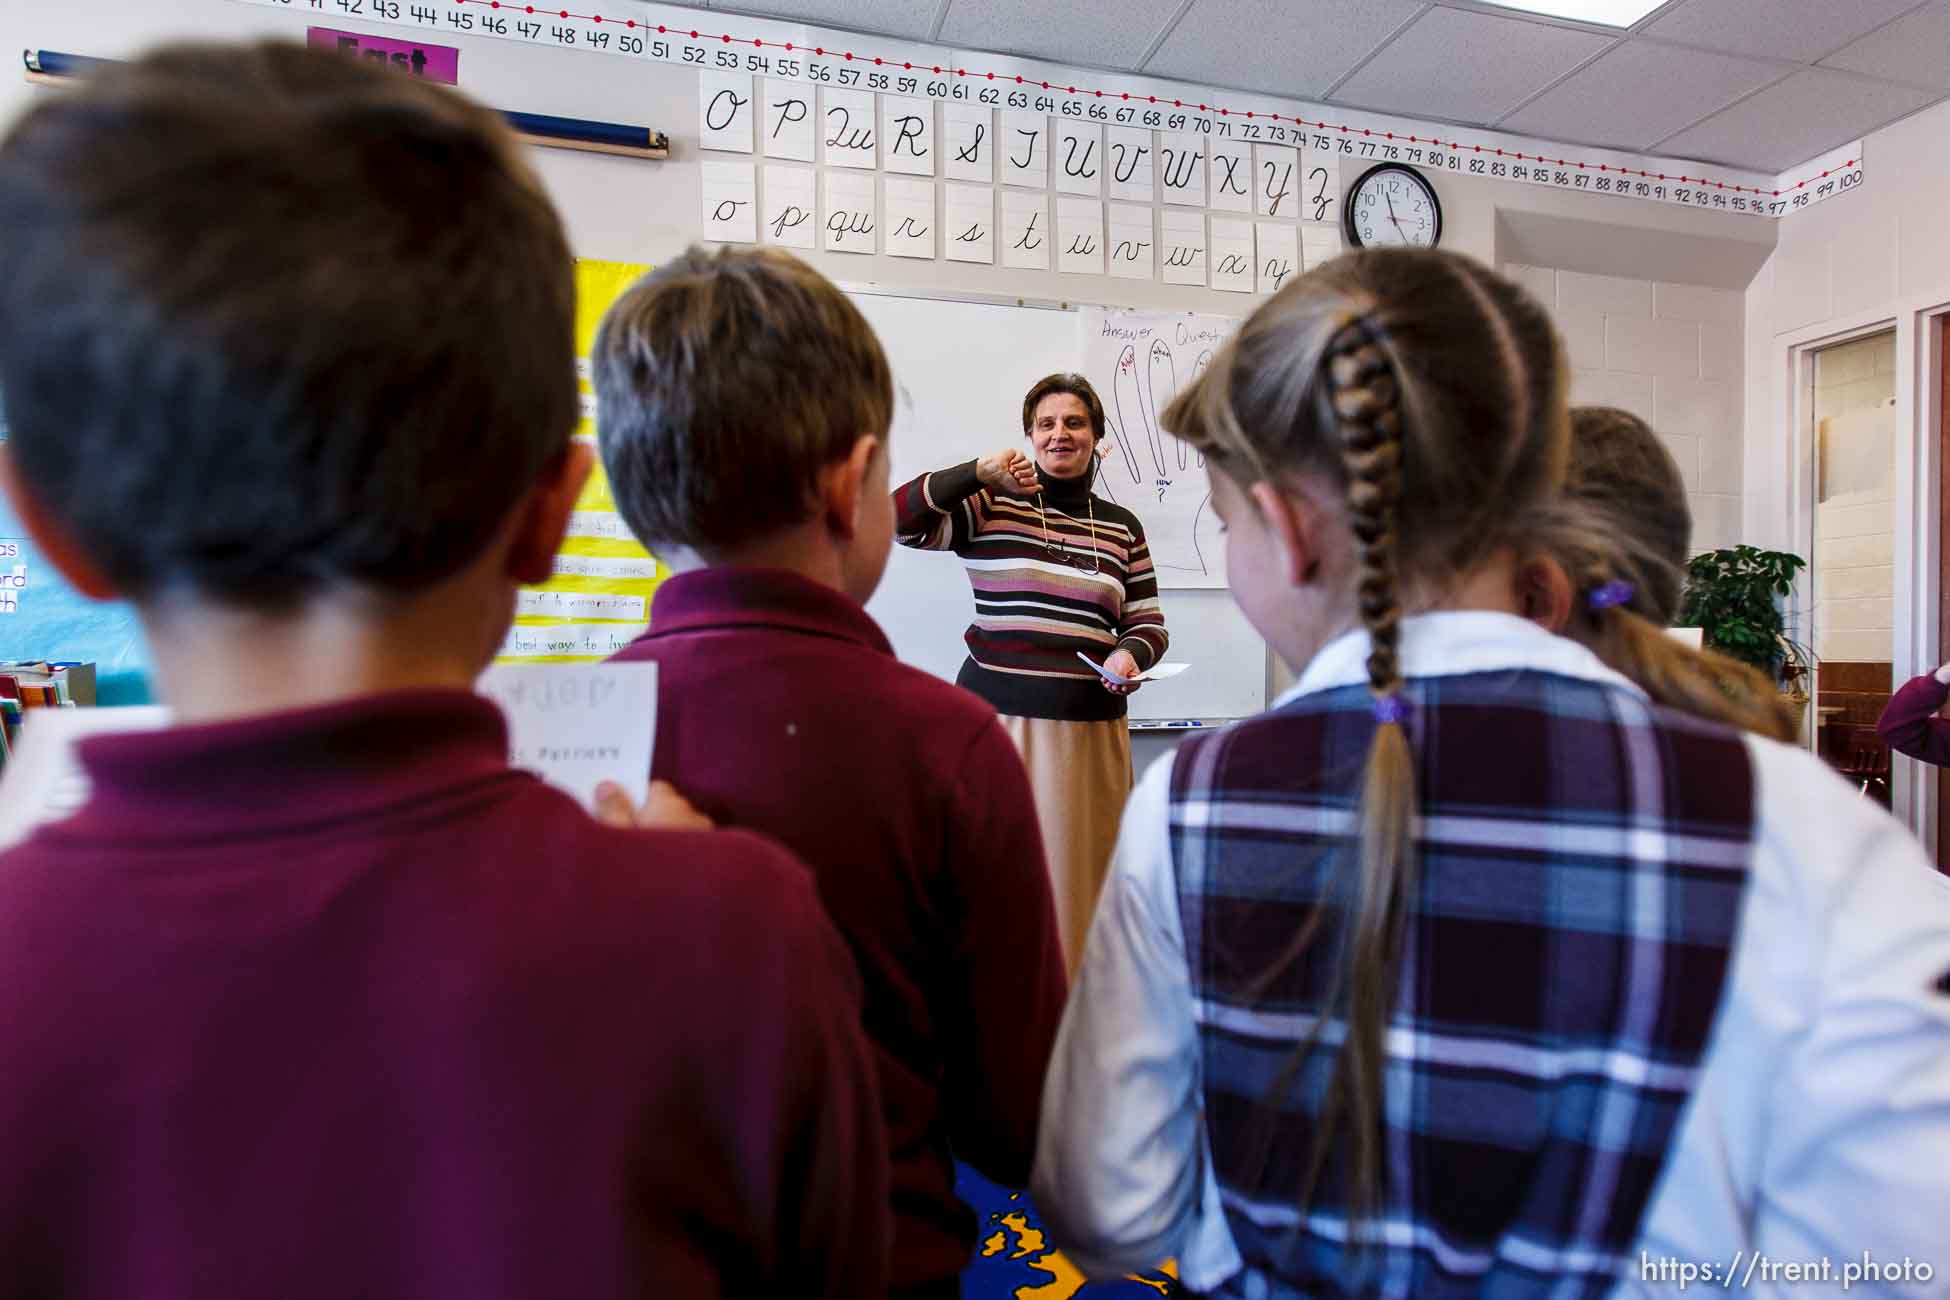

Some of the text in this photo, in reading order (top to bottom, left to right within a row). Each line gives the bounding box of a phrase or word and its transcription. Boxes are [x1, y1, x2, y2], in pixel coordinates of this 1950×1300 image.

[337, 0, 363, 14] 42
[373, 0, 399, 19] 43
[411, 5, 437, 24] 44
[448, 11, 473, 29] 45
[482, 16, 507, 34] 46
[517, 21, 541, 39] 47
[552, 26, 576, 44] 48
[587, 31, 609, 48] 49
[618, 35, 642, 54] 50
[651, 41, 669, 58] 51
[682, 46, 705, 64] 52
[715, 51, 738, 69] 53
[746, 56, 770, 73] 54
[777, 59, 800, 76] 55
[808, 64, 830, 81] 56
[838, 69, 860, 85] 57
[867, 73, 888, 89] 58
[897, 77, 917, 94] 59
[927, 81, 947, 97] 60
[953, 84, 968, 100] 61
[979, 88, 999, 104] 62
[1008, 91, 1027, 108] 63
[1035, 96, 1054, 112] 64
[1062, 101, 1082, 116] 65
[1089, 104, 1107, 119] 66
[1116, 108, 1135, 122] 67
[1143, 110, 1161, 126] 68
[1168, 114, 1186, 130] 69
[1193, 117, 1211, 133] 70
[1217, 122, 1231, 136] 71
[1240, 124, 1260, 138] 72
[1267, 126, 1285, 140] 73
[1291, 130, 1307, 146] 74
[1313, 135, 1330, 150] 75
[1336, 139, 1352, 153] 76
[1359, 142, 1376, 156] 77
[1382, 145, 1398, 159] 78
[1405, 148, 1422, 161] 79
[1429, 152, 1443, 166] 80
[1449, 156, 1460, 169] 81
[1469, 159, 1485, 173] 82
[1491, 162, 1505, 176] 83
[1513, 166, 1527, 179] 84
[1533, 169, 1548, 182] 85
[1555, 172, 1568, 184] 86
[1575, 175, 1590, 187] 87
[1596, 177, 1610, 190] 88
[1617, 180, 1630, 192] 89
[1636, 183, 1649, 196] 90
[1655, 186, 1666, 198] 91
[1675, 189, 1690, 202] 92
[1696, 192, 1708, 205] 93
[1713, 195, 1726, 206] 94
[1732, 197, 1745, 210] 95
[1752, 200, 1763, 213] 96
[1769, 201, 1787, 214] 97
[1793, 192, 1809, 207] 98
[1817, 181, 1834, 198] 99
[1840, 170, 1863, 190] 100
[706, 89, 748, 130] O
[773, 100, 807, 139] P
[893, 116, 927, 156] R
[955, 124, 985, 163] S
[1010, 130, 1038, 168] T
[1063, 136, 1096, 178] U
[1111, 143, 1150, 182] V
[1161, 148, 1204, 189] W
[1213, 155, 1247, 195] X
[1264, 161, 1292, 216] Y
[1309, 167, 1333, 221] Z
[1376, 184, 1384, 195] 11
[1389, 181, 1400, 193] 12
[1364, 193, 1376, 206] 10
[1414, 200, 1422, 212] 2
[1360, 210, 1368, 223] 9
[1417, 218, 1425, 230] 3
[1364, 227, 1373, 240] 8
[713, 200, 1291, 290] o p qu r s t u v w x y
[1102, 319, 1217, 345] Answer Quest
[1158, 488, 1165, 503] ?
[515, 632, 537, 650] best
[585, 636, 597, 650] to
